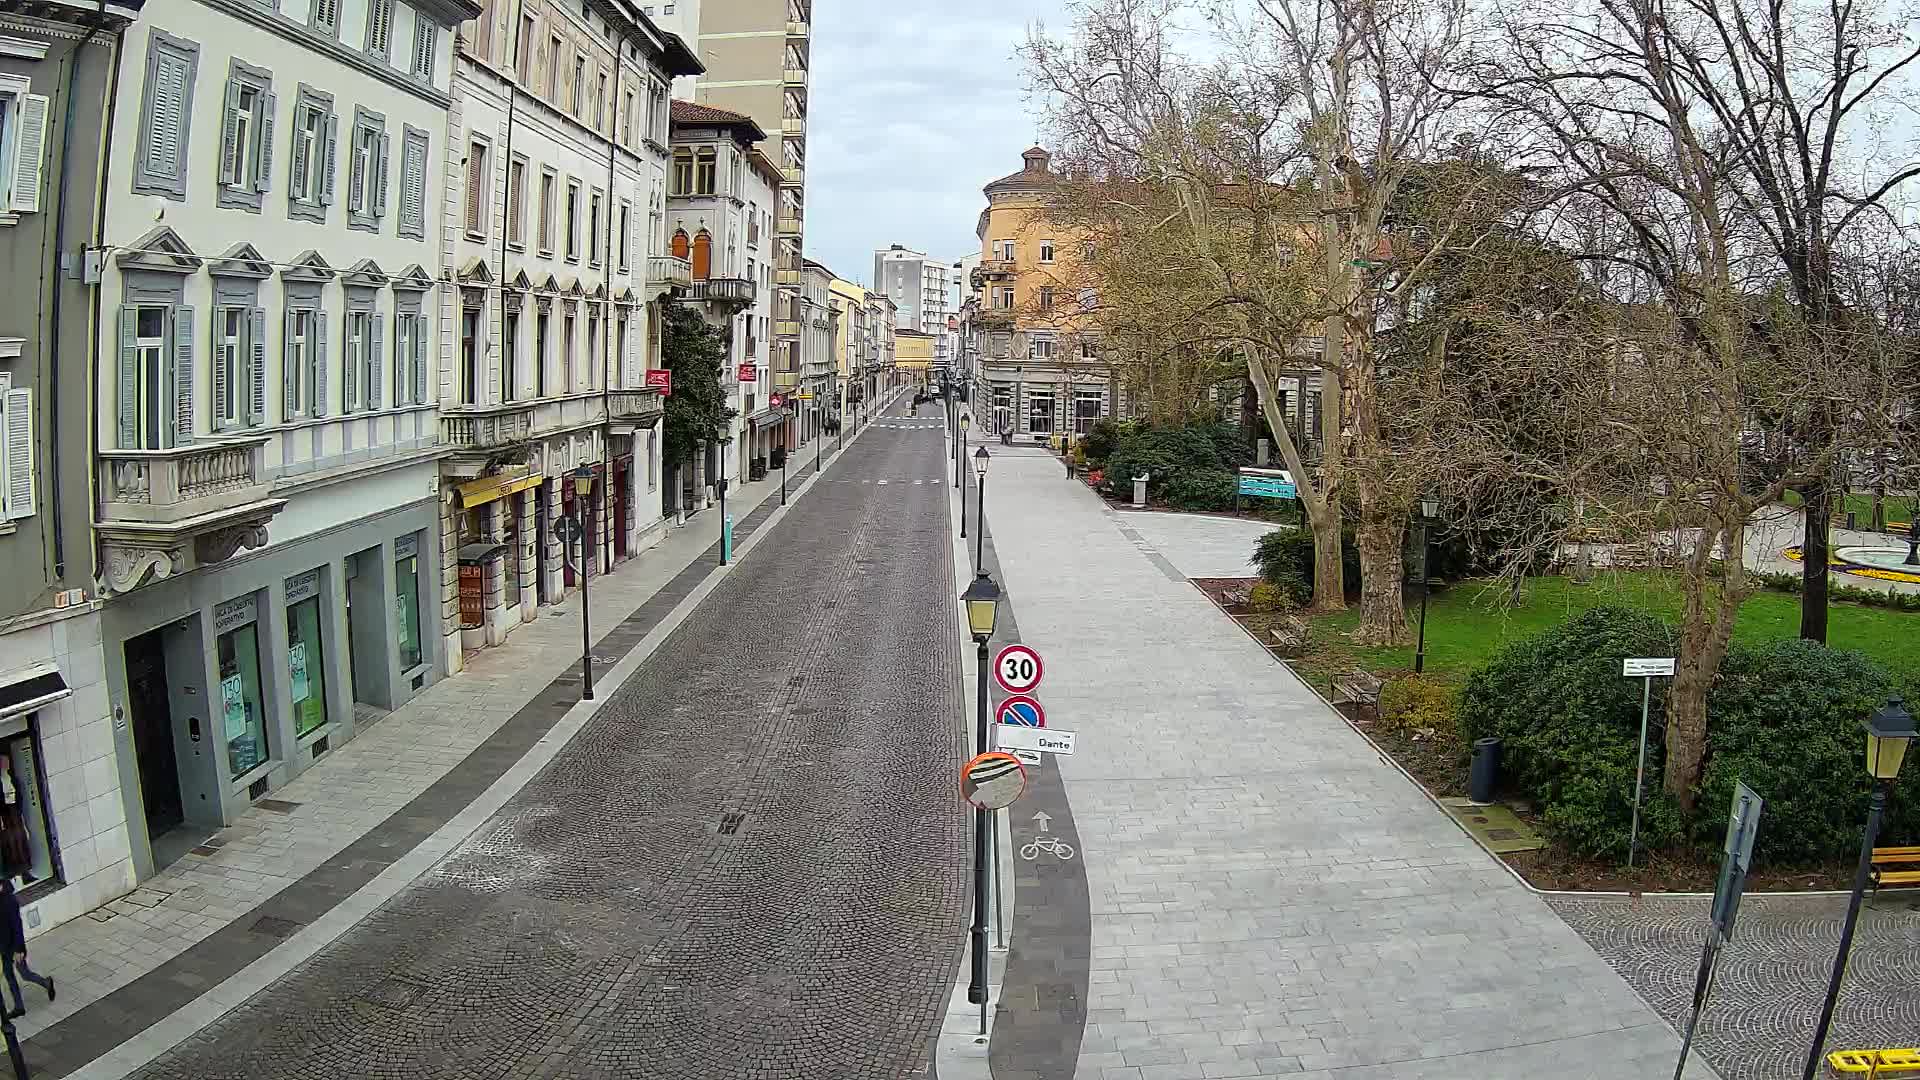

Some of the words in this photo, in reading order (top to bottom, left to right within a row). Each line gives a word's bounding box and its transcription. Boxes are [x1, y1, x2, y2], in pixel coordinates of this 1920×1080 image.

[1005, 658, 1033, 681] 30
[223, 677, 241, 700] 130
[1038, 738, 1071, 750] Dante
